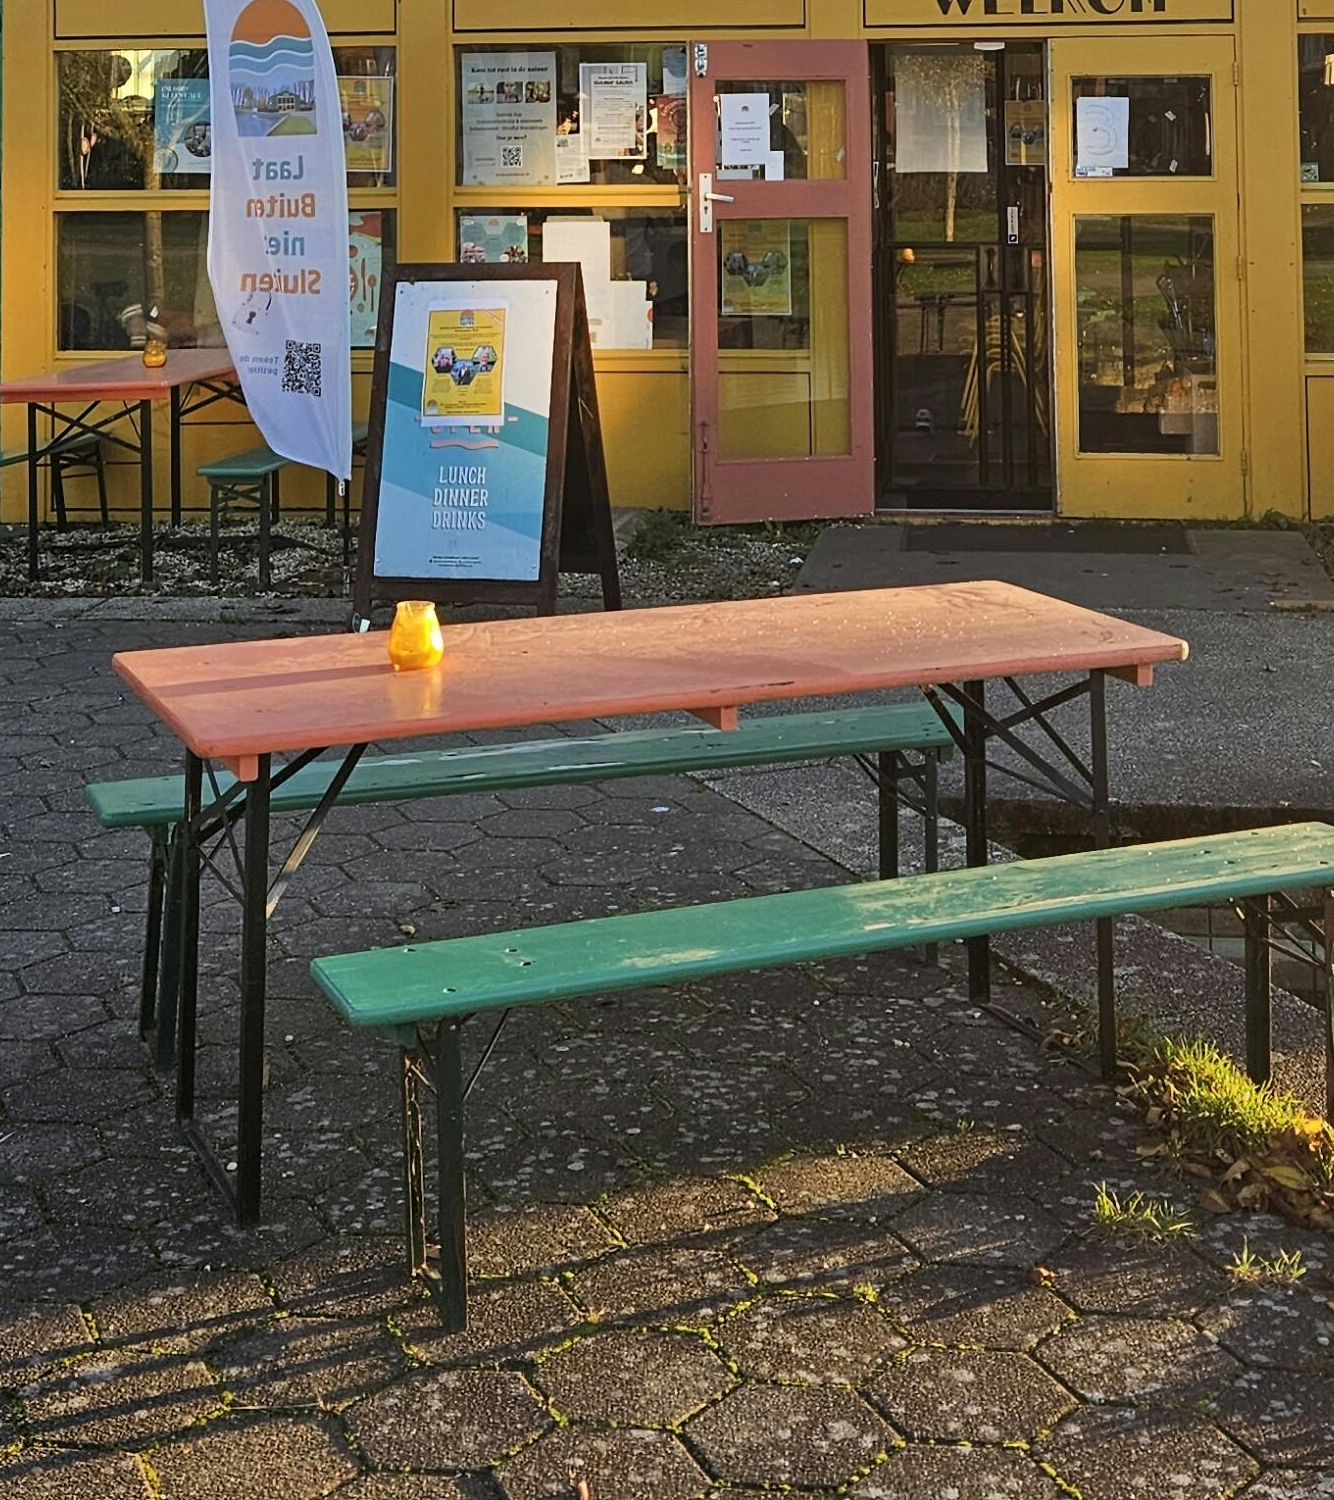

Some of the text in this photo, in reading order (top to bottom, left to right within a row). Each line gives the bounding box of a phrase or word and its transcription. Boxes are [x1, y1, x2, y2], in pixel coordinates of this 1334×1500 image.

[438, 466, 487, 485] LUNCH
[433, 488, 489, 508] DINNER
[431, 511, 487, 531] DRINKS
